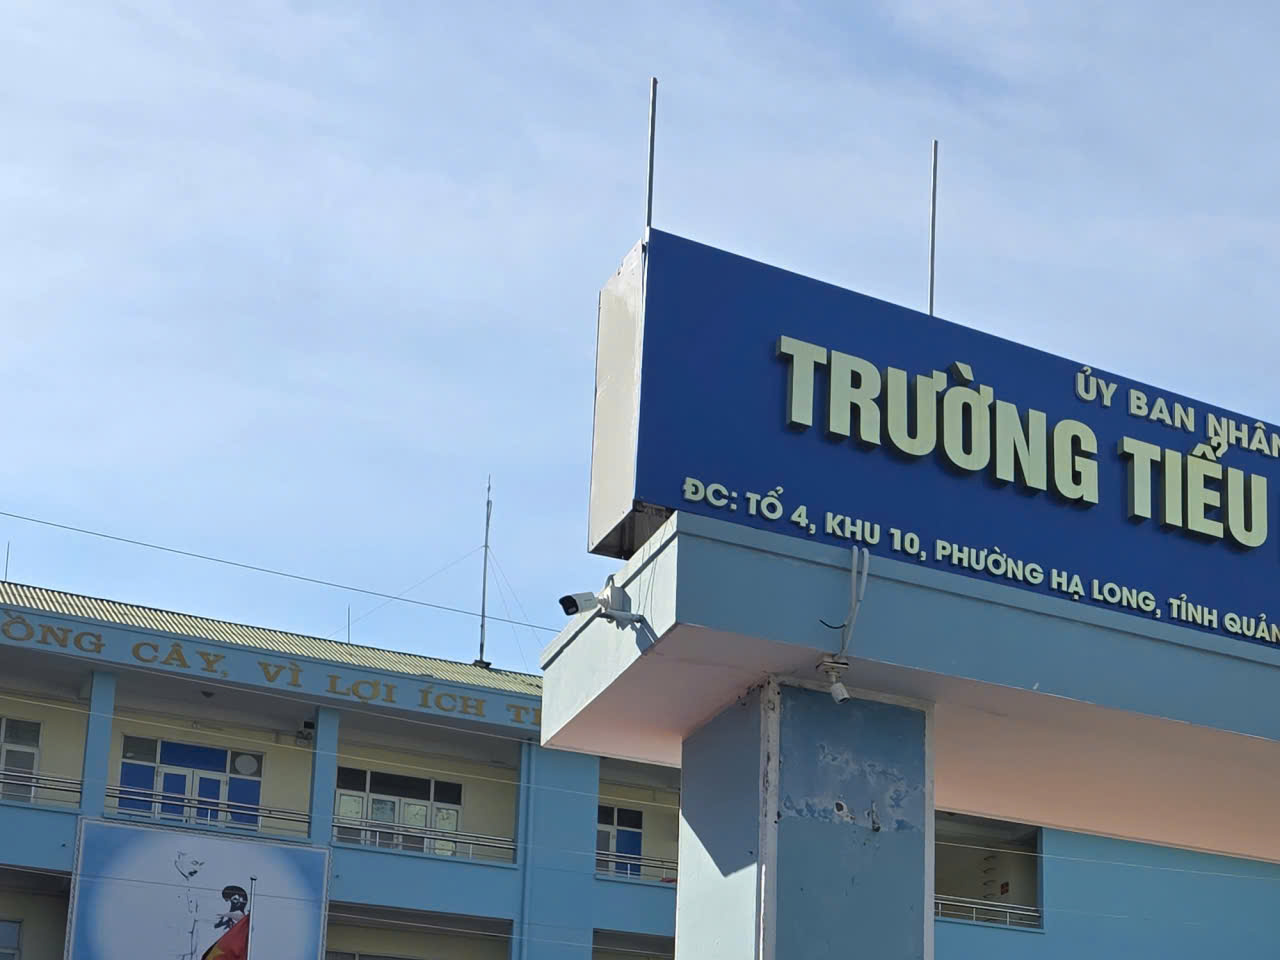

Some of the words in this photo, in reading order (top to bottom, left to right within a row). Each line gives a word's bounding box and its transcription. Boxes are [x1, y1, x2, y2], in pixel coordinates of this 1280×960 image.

[777, 335, 1099, 504] TRƯỜNG
[1118, 435, 1268, 548] TIỂU
[1075, 365, 1118, 408] ỦY
[1128, 389, 1196, 431] BAN
[682, 476, 738, 511] ĐC:
[745, 485, 784, 521] TỔ
[790, 503, 816, 535] 4,
[824, 512, 881, 546] KHU
[888, 527, 927, 561] 10,
[935, 539, 1044, 585] PHƯỜNG
[1050, 568, 1082, 600] HẠ
[1091, 578, 1162, 619] LONG,
[1168, 595, 1218, 629] TỈNH
[132, 641, 229, 679] CÂY,
[258, 658, 302, 688] VÌ
[326, 674, 397, 705] LỢI
[418, 686, 486, 717] ÍCH
